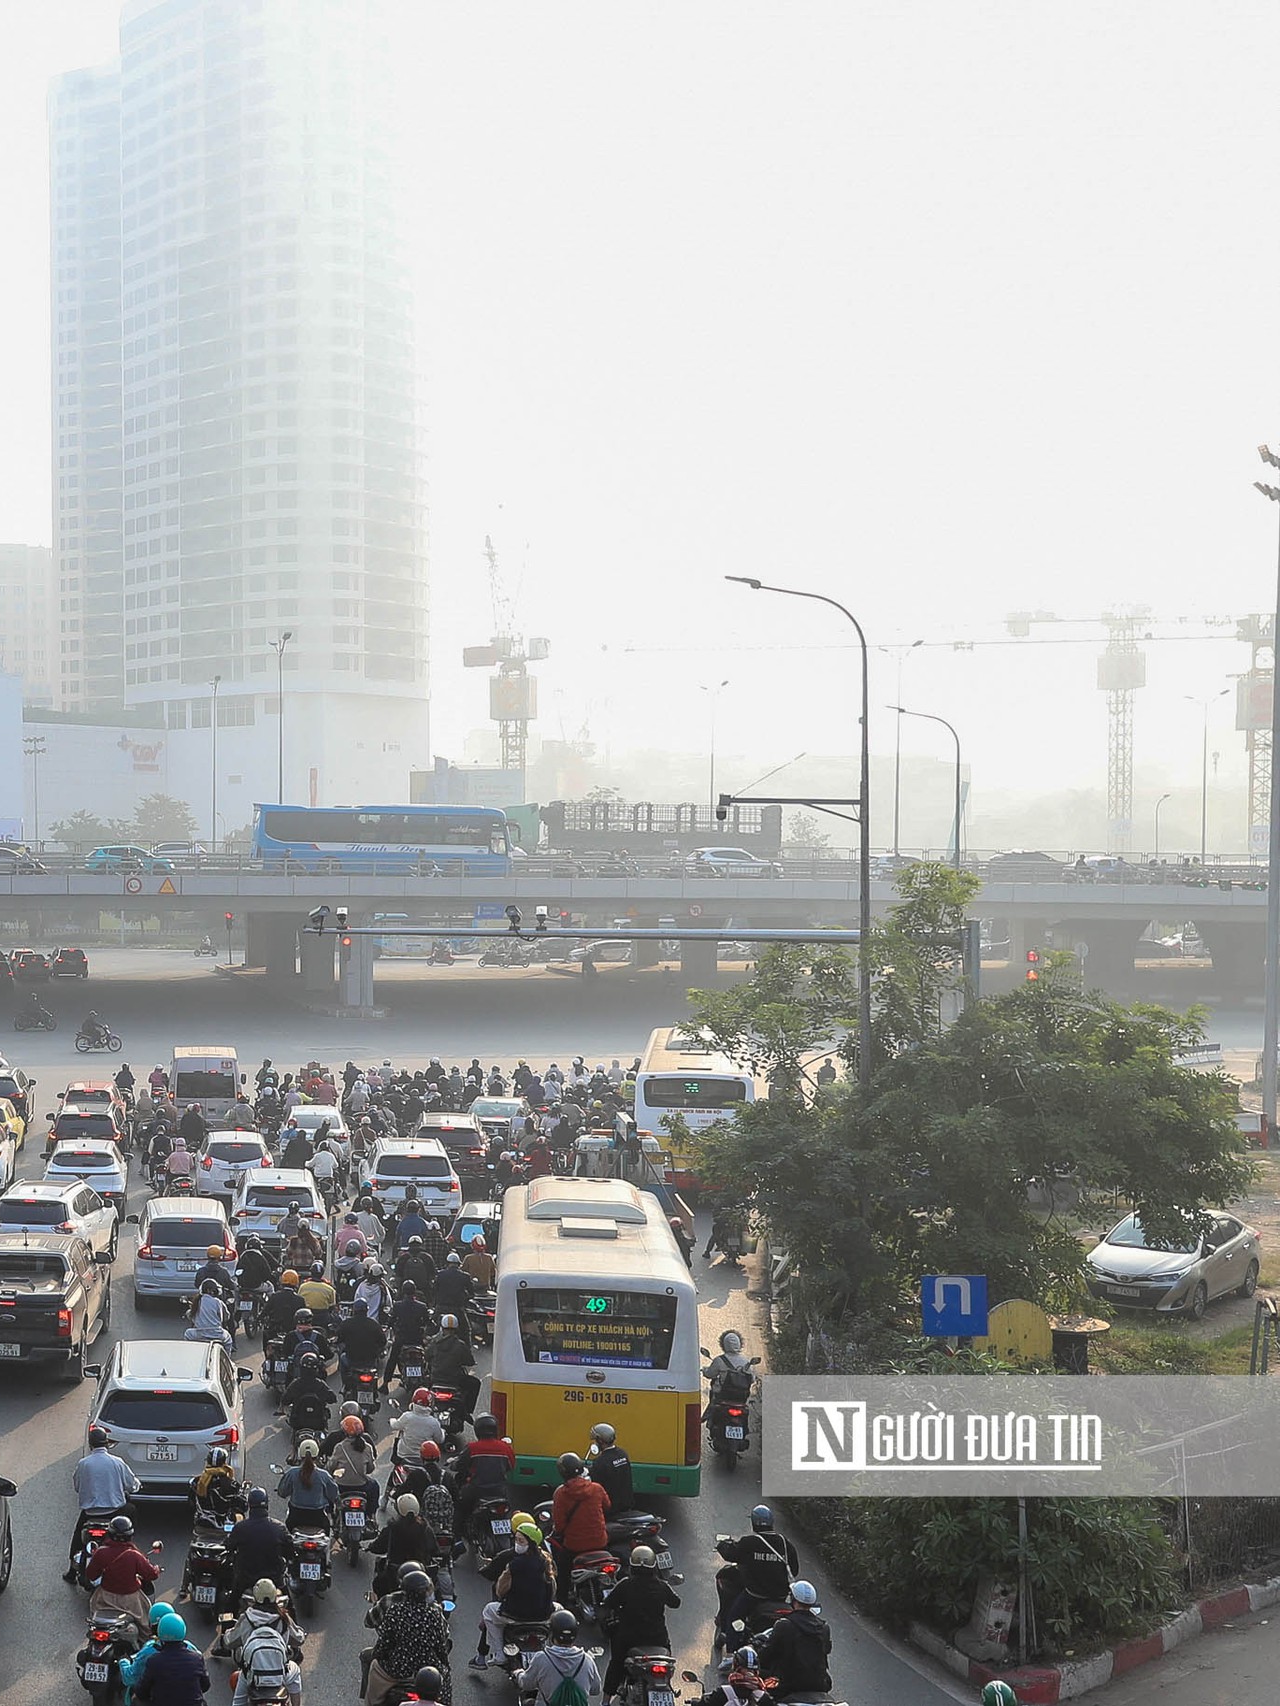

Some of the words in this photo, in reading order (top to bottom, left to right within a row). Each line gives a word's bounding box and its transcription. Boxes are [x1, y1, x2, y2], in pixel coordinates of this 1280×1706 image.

[585, 1297, 607, 1313] 49
[544, 1321, 564, 1332] CÔNG
[565, 1323, 574, 1332] TY
[575, 1324, 585, 1333] CP
[587, 1324, 597, 1333] XE
[598, 1323, 623, 1334] KHÁCH
[624, 1324, 635, 1335] HÀ
[636, 1325, 649, 1337] NỘI
[562, 1339, 595, 1350] HOTLINE:
[563, 1390, 628, 1404] 29G-013.05
